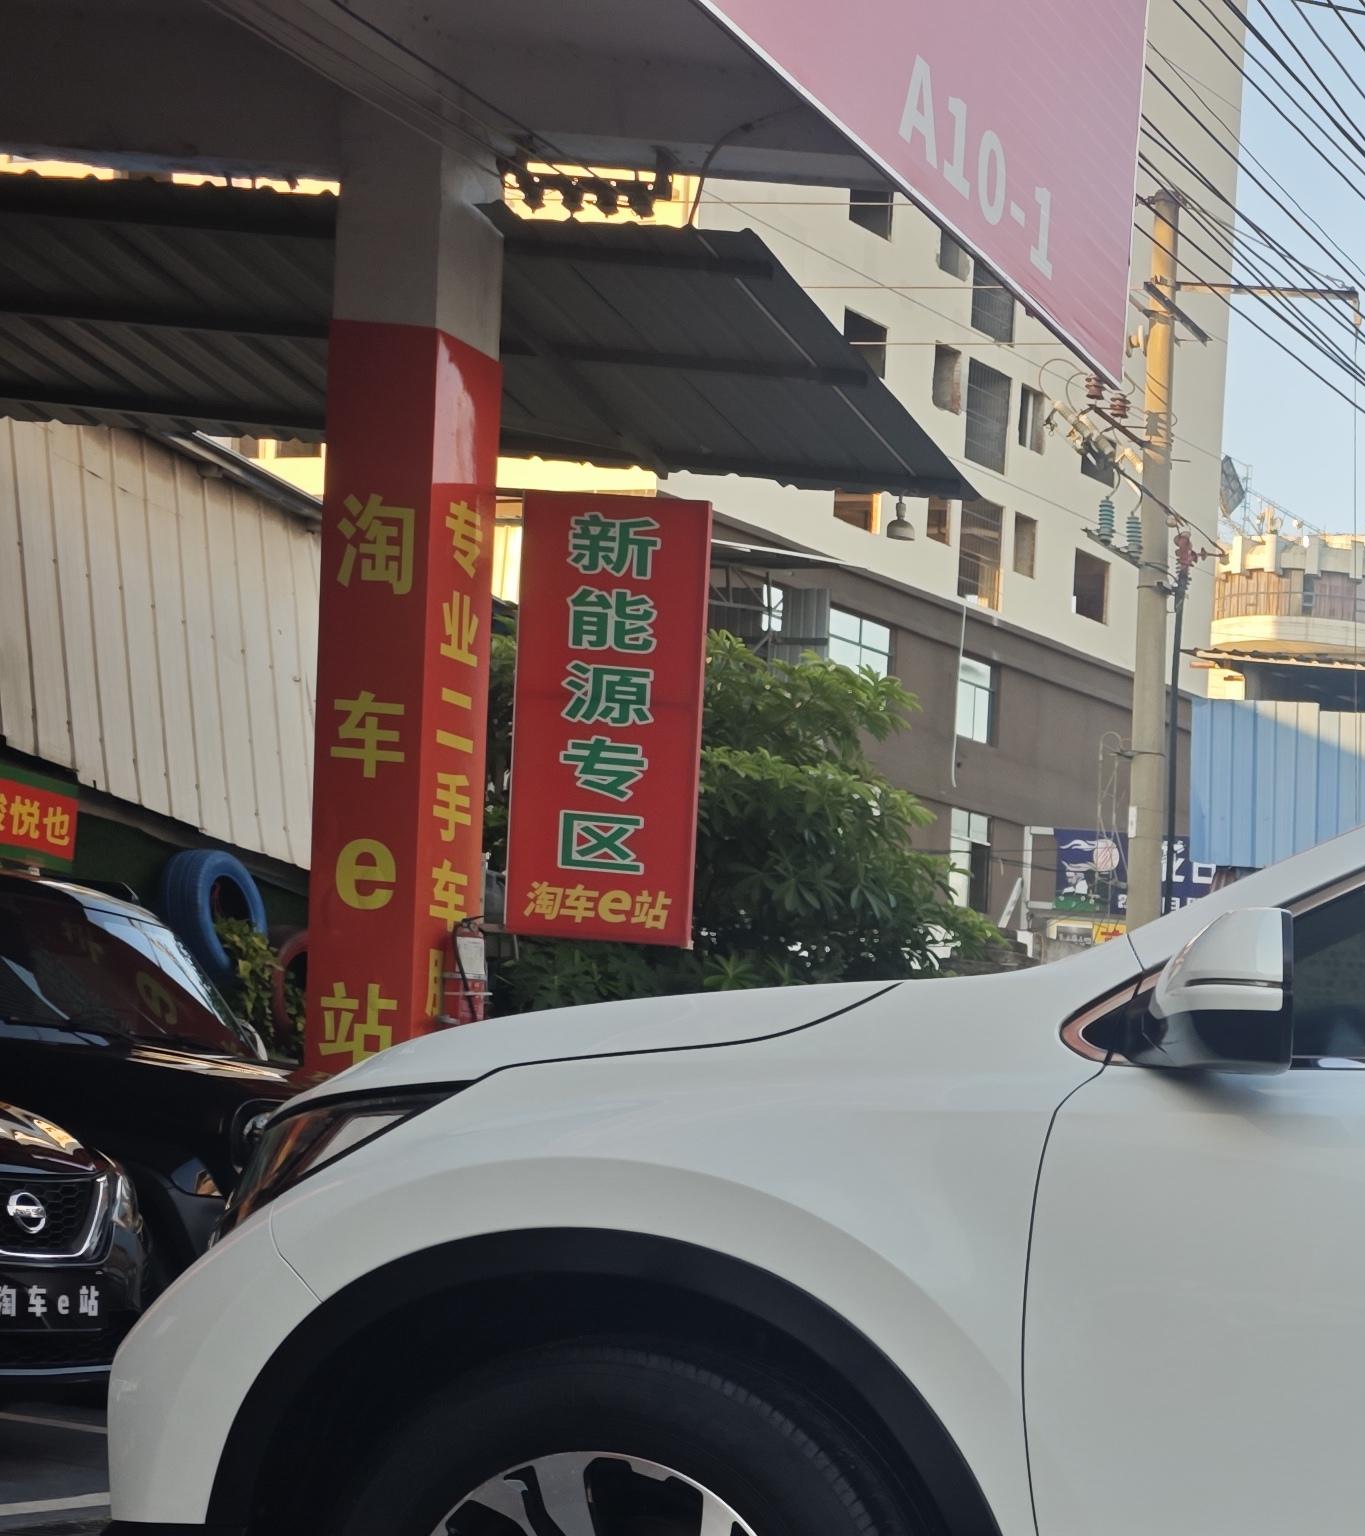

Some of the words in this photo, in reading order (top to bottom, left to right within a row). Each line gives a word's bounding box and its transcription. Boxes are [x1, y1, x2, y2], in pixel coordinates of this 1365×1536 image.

[898, 54, 1053, 281] A10-1
[556, 512, 661, 876] 新能源专区
[523, 880, 672, 930] 淘车e站
